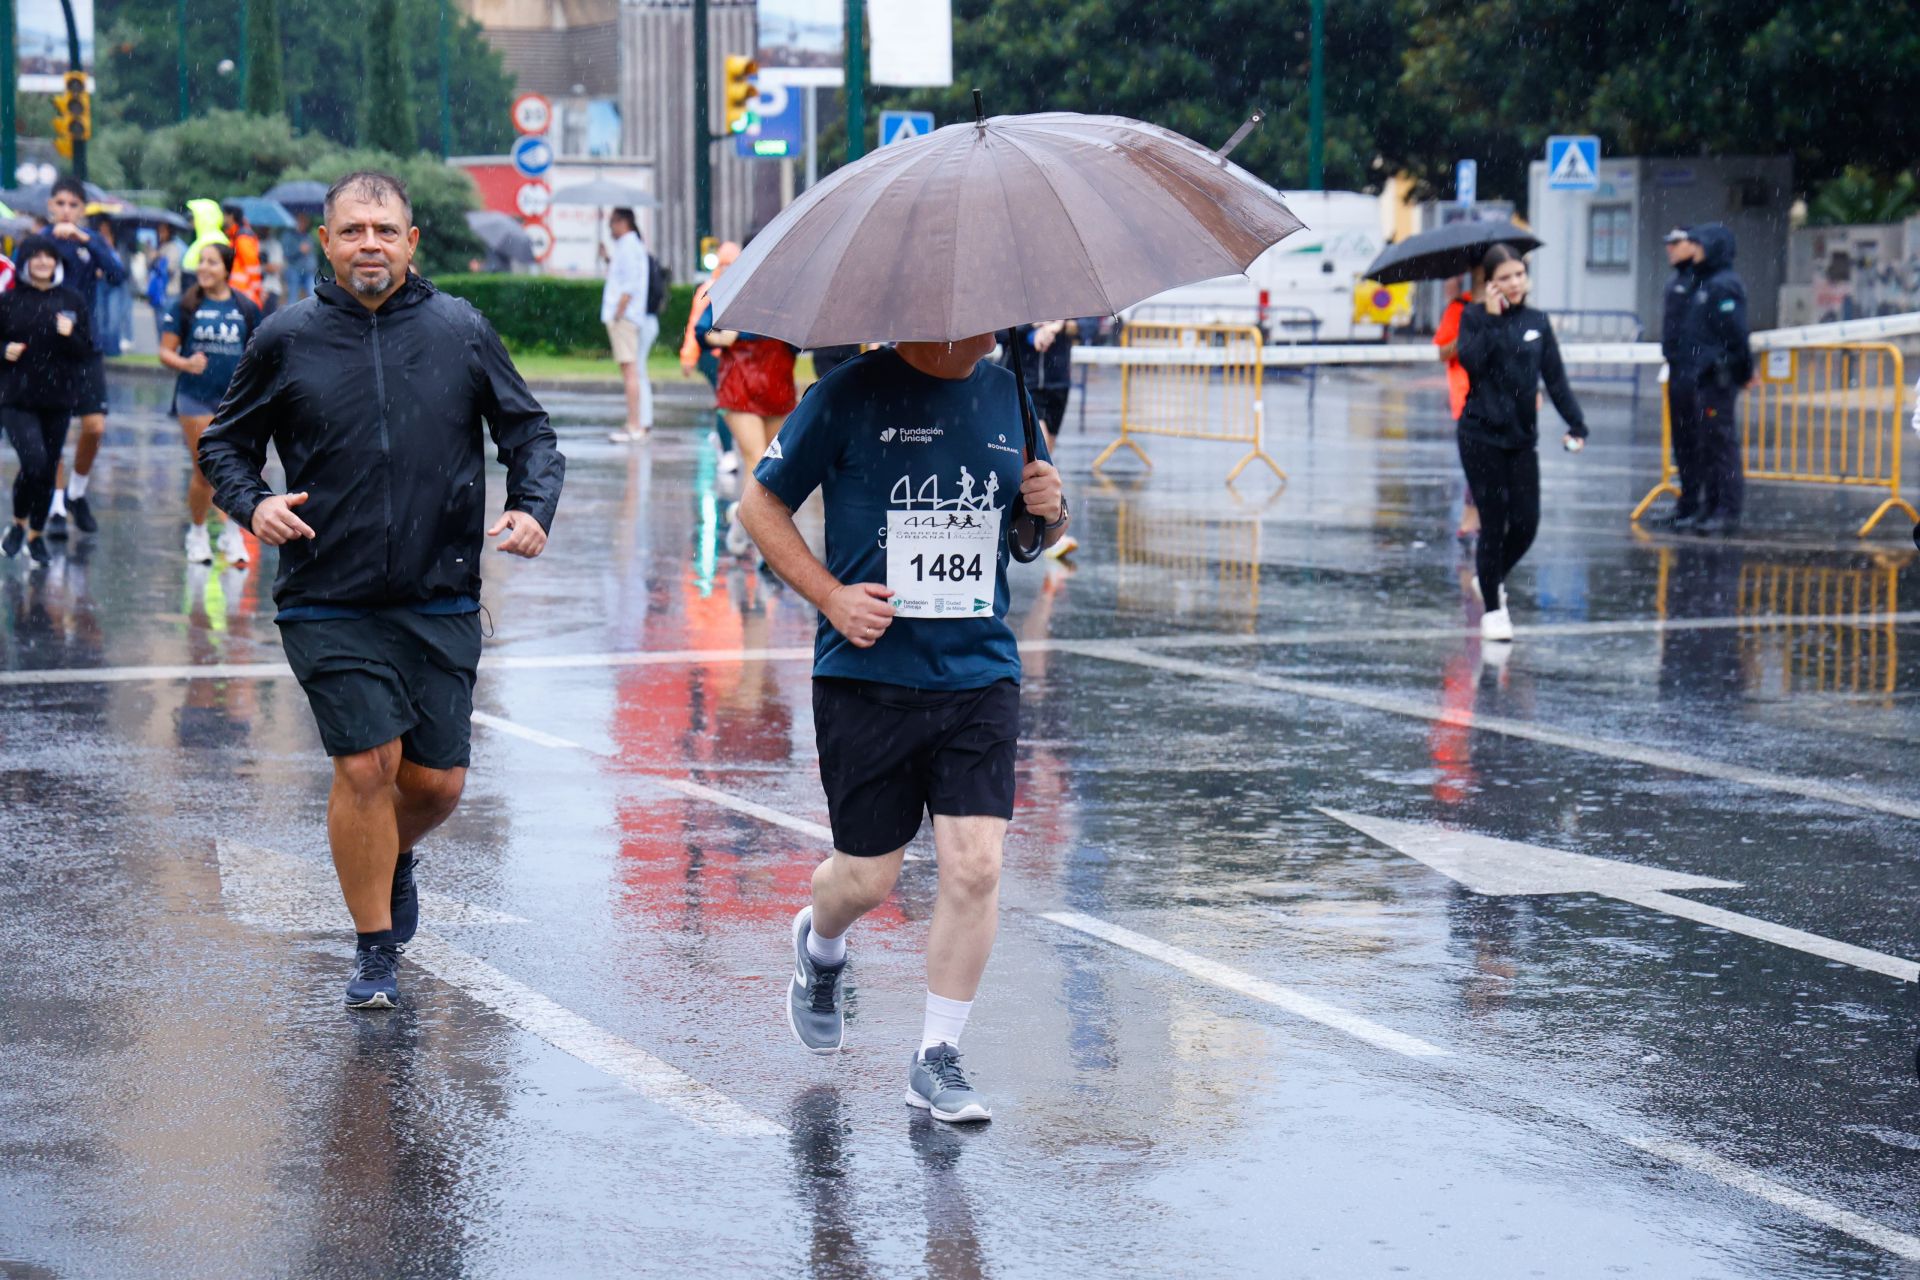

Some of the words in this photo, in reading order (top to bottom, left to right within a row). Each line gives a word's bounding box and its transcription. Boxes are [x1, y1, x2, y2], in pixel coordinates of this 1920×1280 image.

[900, 427, 943, 435] Fundación
[900, 434, 932, 443] Unicaja
[910, 553, 982, 582] 1484
